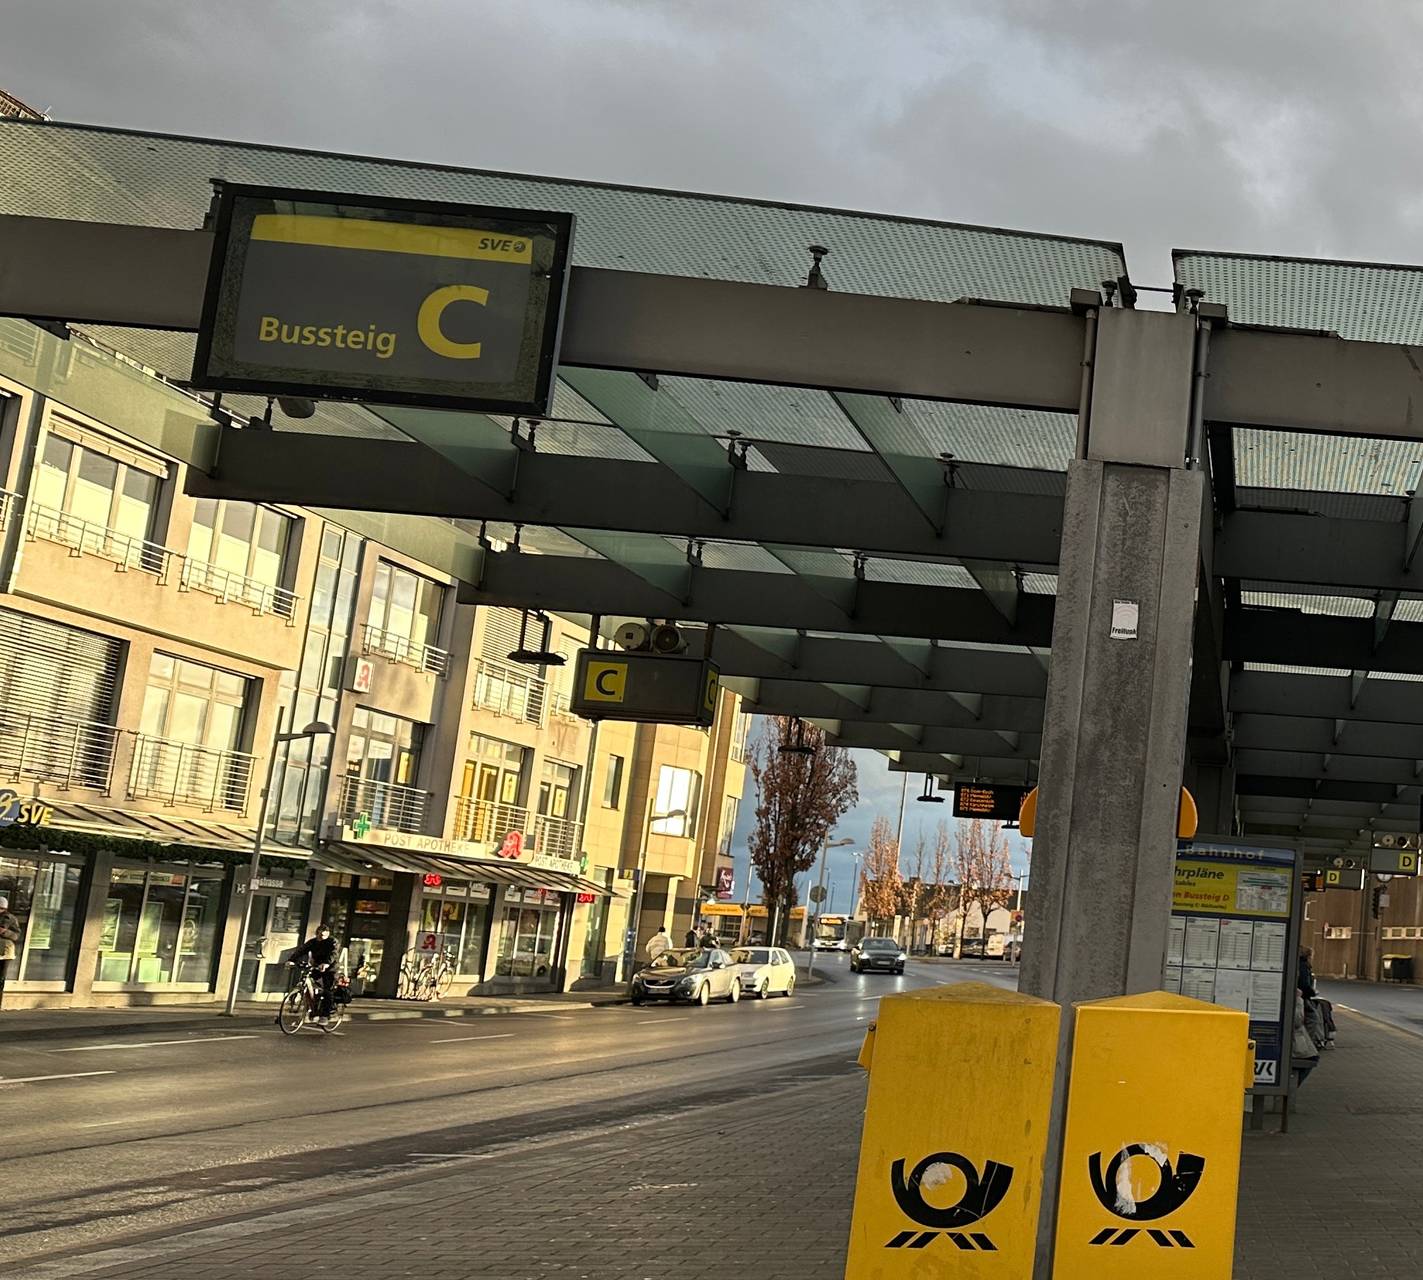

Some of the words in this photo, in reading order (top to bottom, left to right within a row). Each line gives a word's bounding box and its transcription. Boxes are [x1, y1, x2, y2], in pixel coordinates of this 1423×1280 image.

[478, 238, 511, 252] SVE
[259, 316, 396, 359] Bussteig
[417, 284, 490, 360] C
[595, 669, 618, 696] C
[17, 804, 54, 826] SVE
[384, 833, 411, 847] POST
[417, 838, 471, 854] APOTHEKE
[1402, 856, 1412, 867] D
[1174, 865, 1225, 880] hrpläne
[1330, 873, 1337, 882] D
